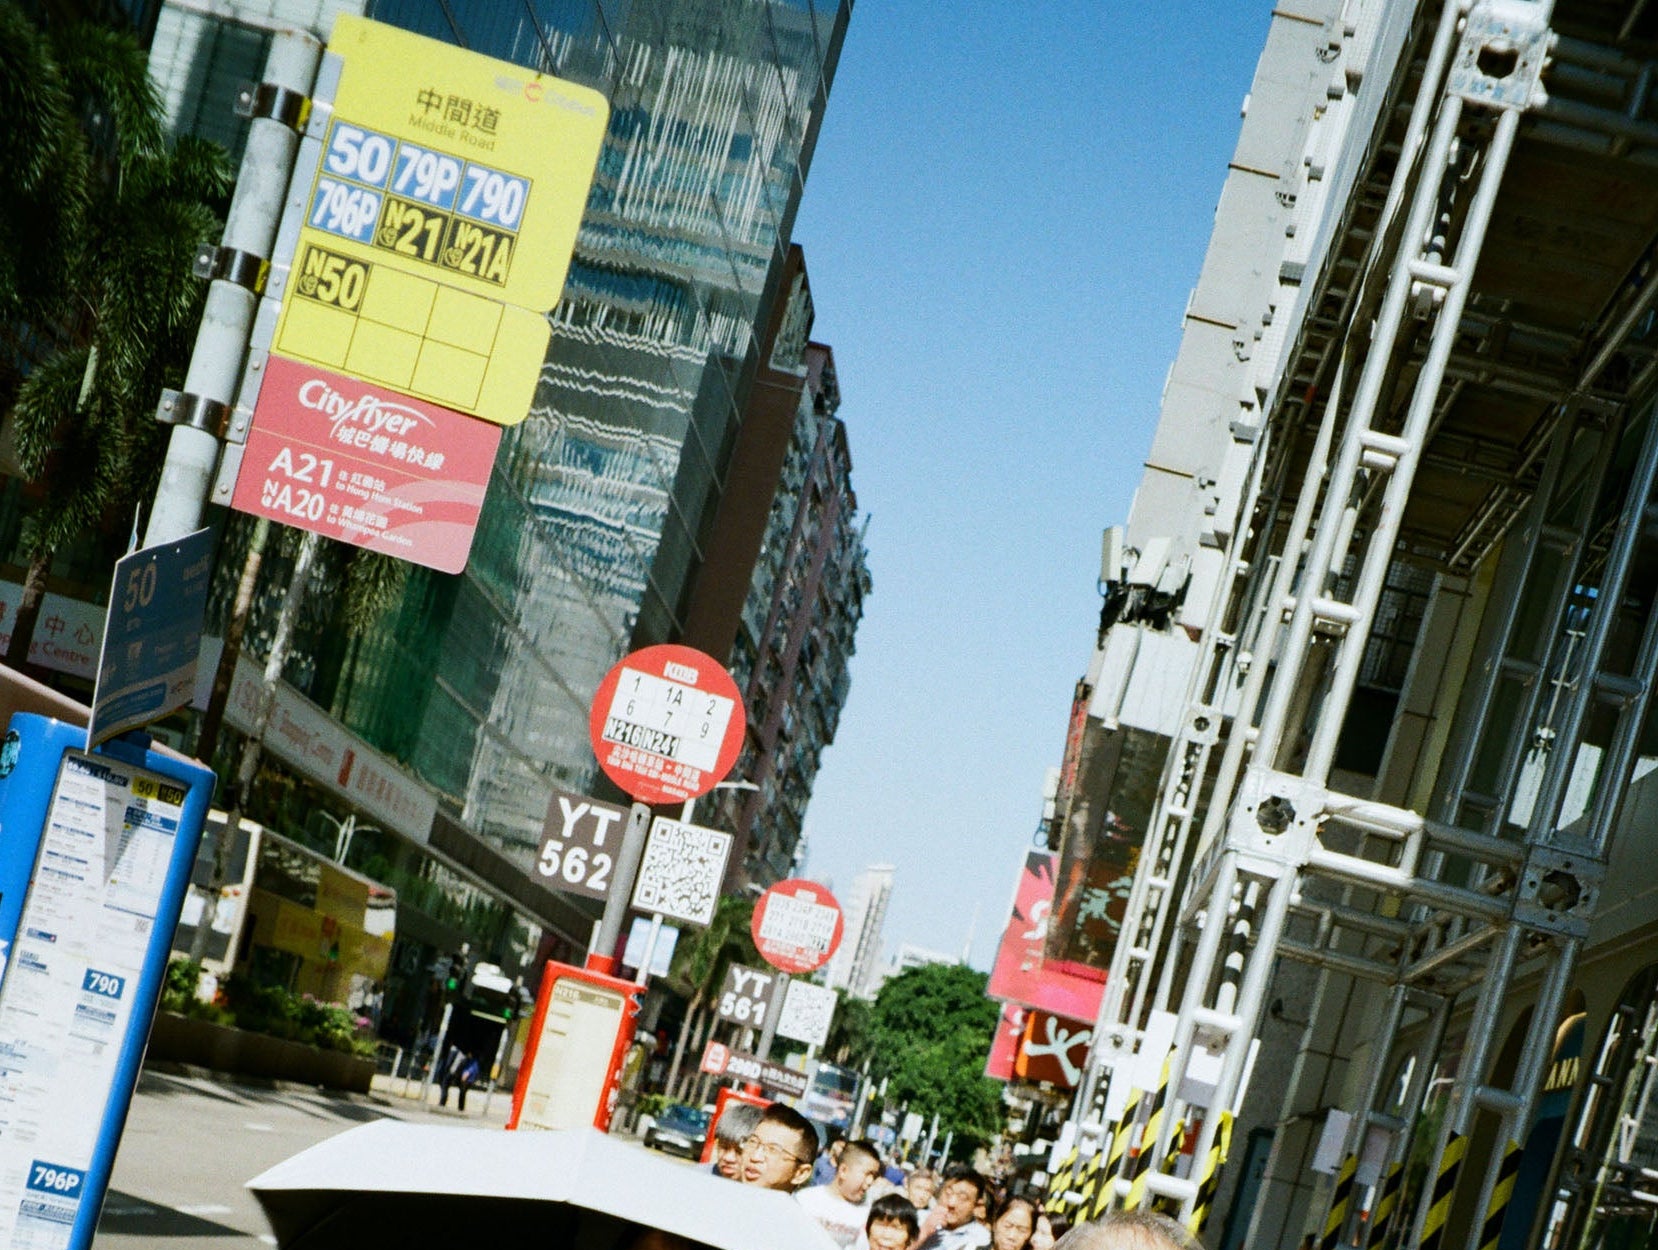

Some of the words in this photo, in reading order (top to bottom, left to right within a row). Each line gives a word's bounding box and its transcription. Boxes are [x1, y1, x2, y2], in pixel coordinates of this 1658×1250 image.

[416, 86, 502, 136] 中間道
[409, 113, 456, 141] Middle
[460, 128, 496, 152] Road
[328, 124, 392, 182] 50
[397, 146, 460, 204] 79P
[460, 165, 522, 225] 790
[312, 180, 378, 243] 796P
[382, 199, 442, 261] N21
[444, 222, 508, 281] N21A
[300, 248, 367, 312] N50
[268, 447, 334, 488] A21
[123, 562, 157, 613] 50
[42, 641, 90, 665] Centre
[605, 717, 641, 745] N216
[134, 779, 155, 798] 50
[558, 797, 621, 848] YT
[538, 840, 612, 892] 562
[88, 972, 119, 995] 790
[731, 967, 772, 999] YT
[719, 993, 766, 1026] 561
[33, 1166, 80, 1192] 796P
